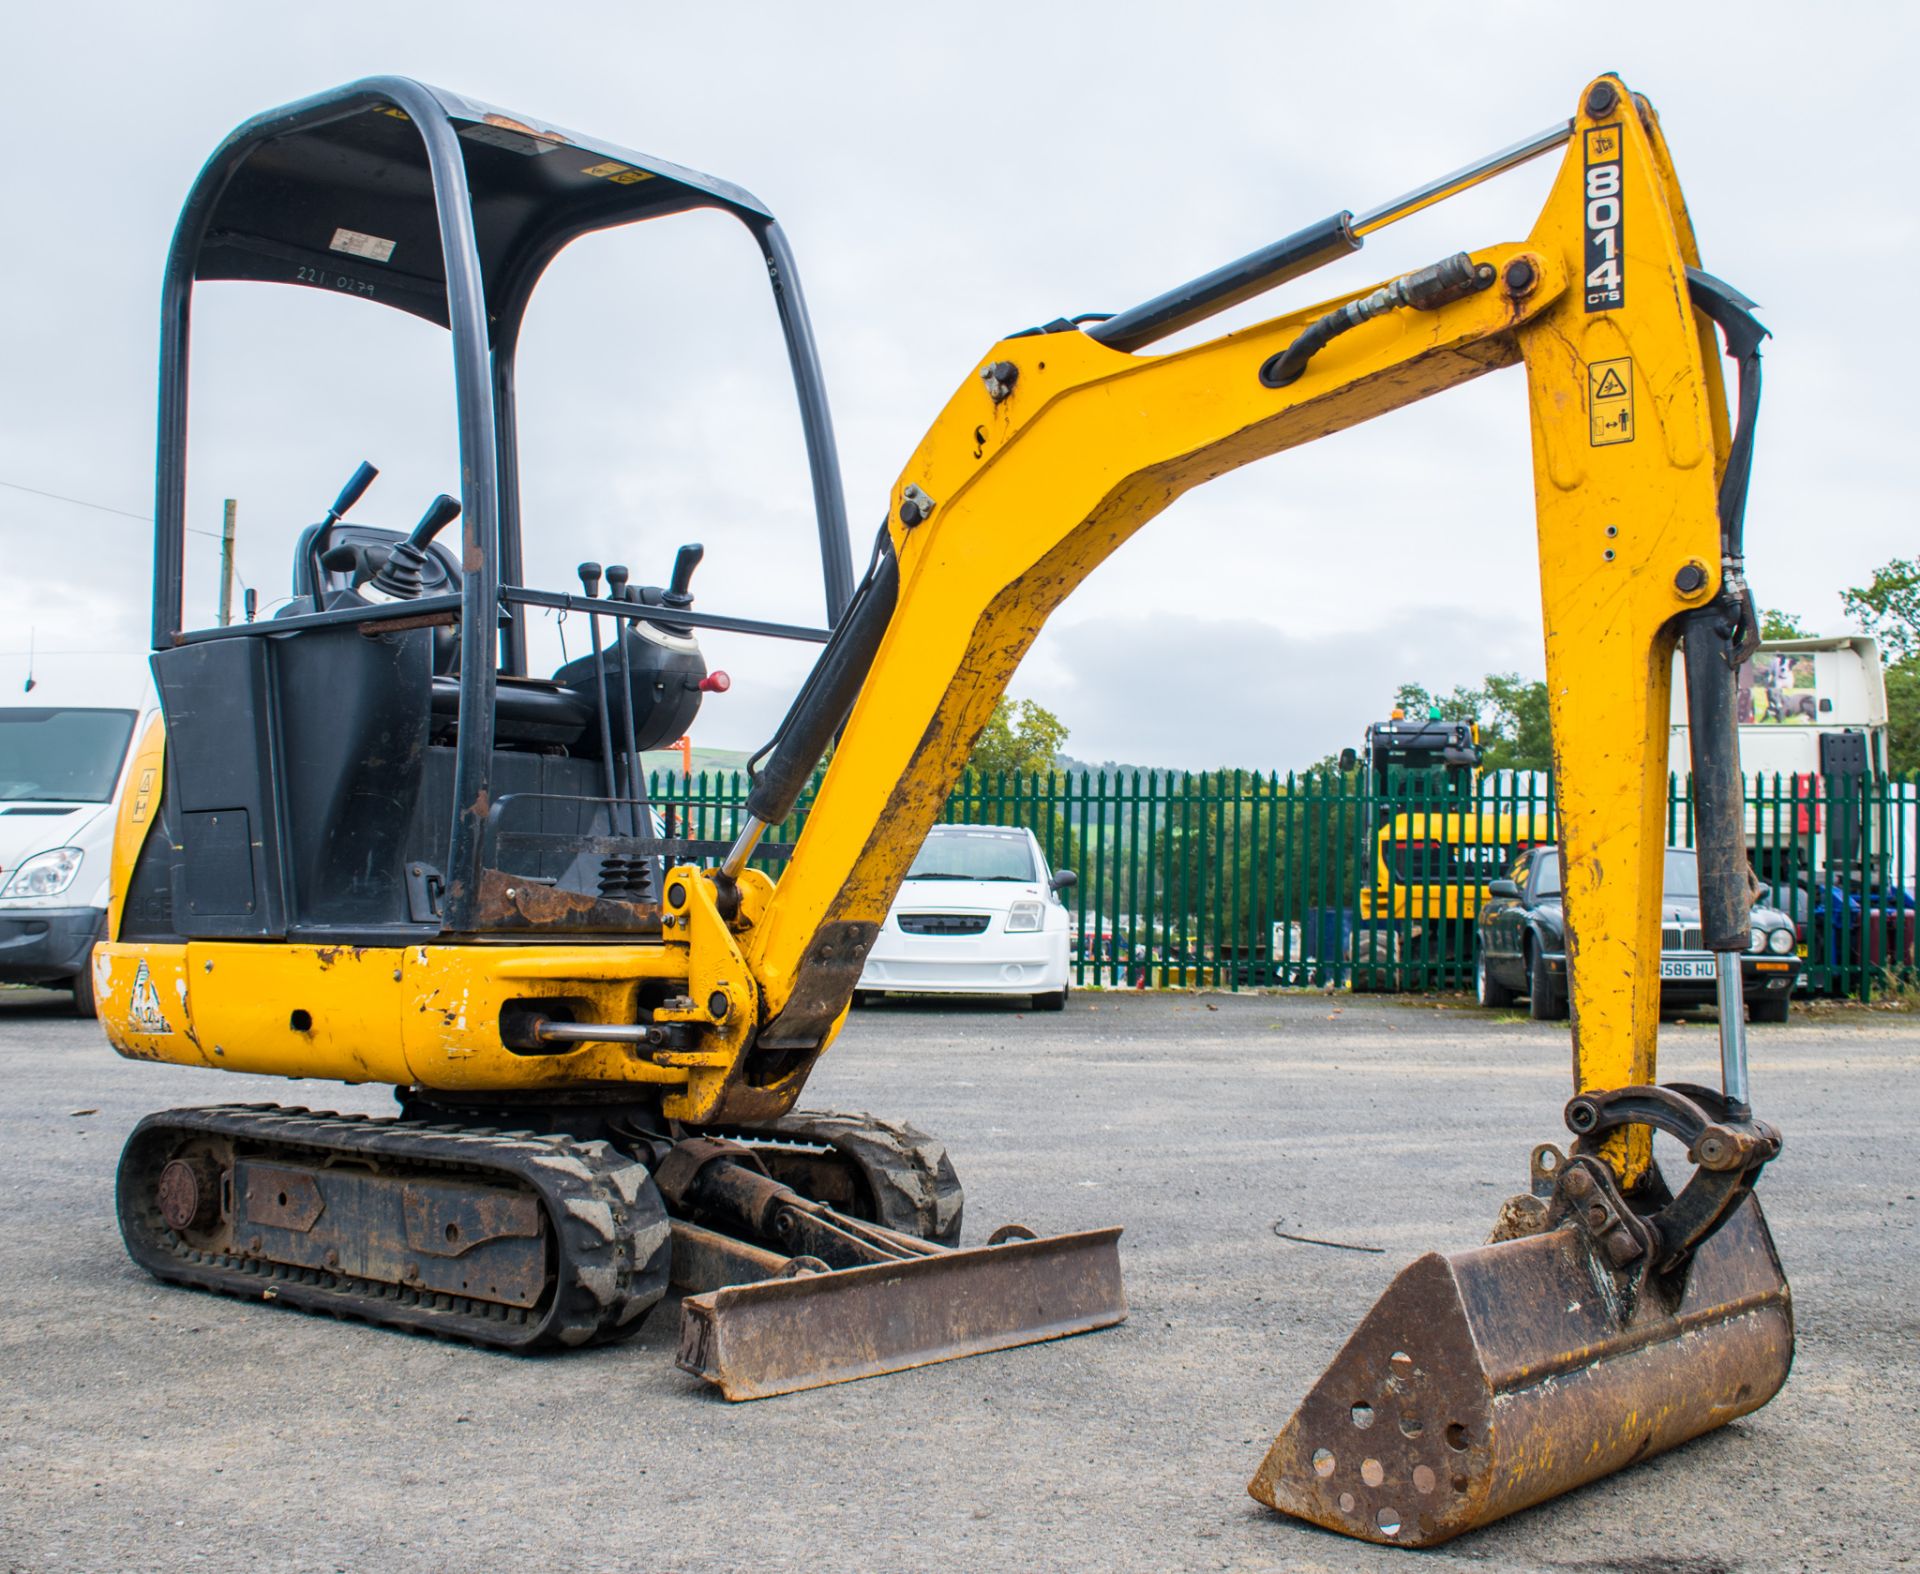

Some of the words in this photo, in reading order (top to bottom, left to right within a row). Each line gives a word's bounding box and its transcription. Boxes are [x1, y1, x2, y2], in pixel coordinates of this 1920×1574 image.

[1594, 137, 1614, 154] JCB
[1586, 164, 1621, 290] 8014
[1587, 290, 1621, 304] CTS
[1660, 963, 1692, 976] 586
